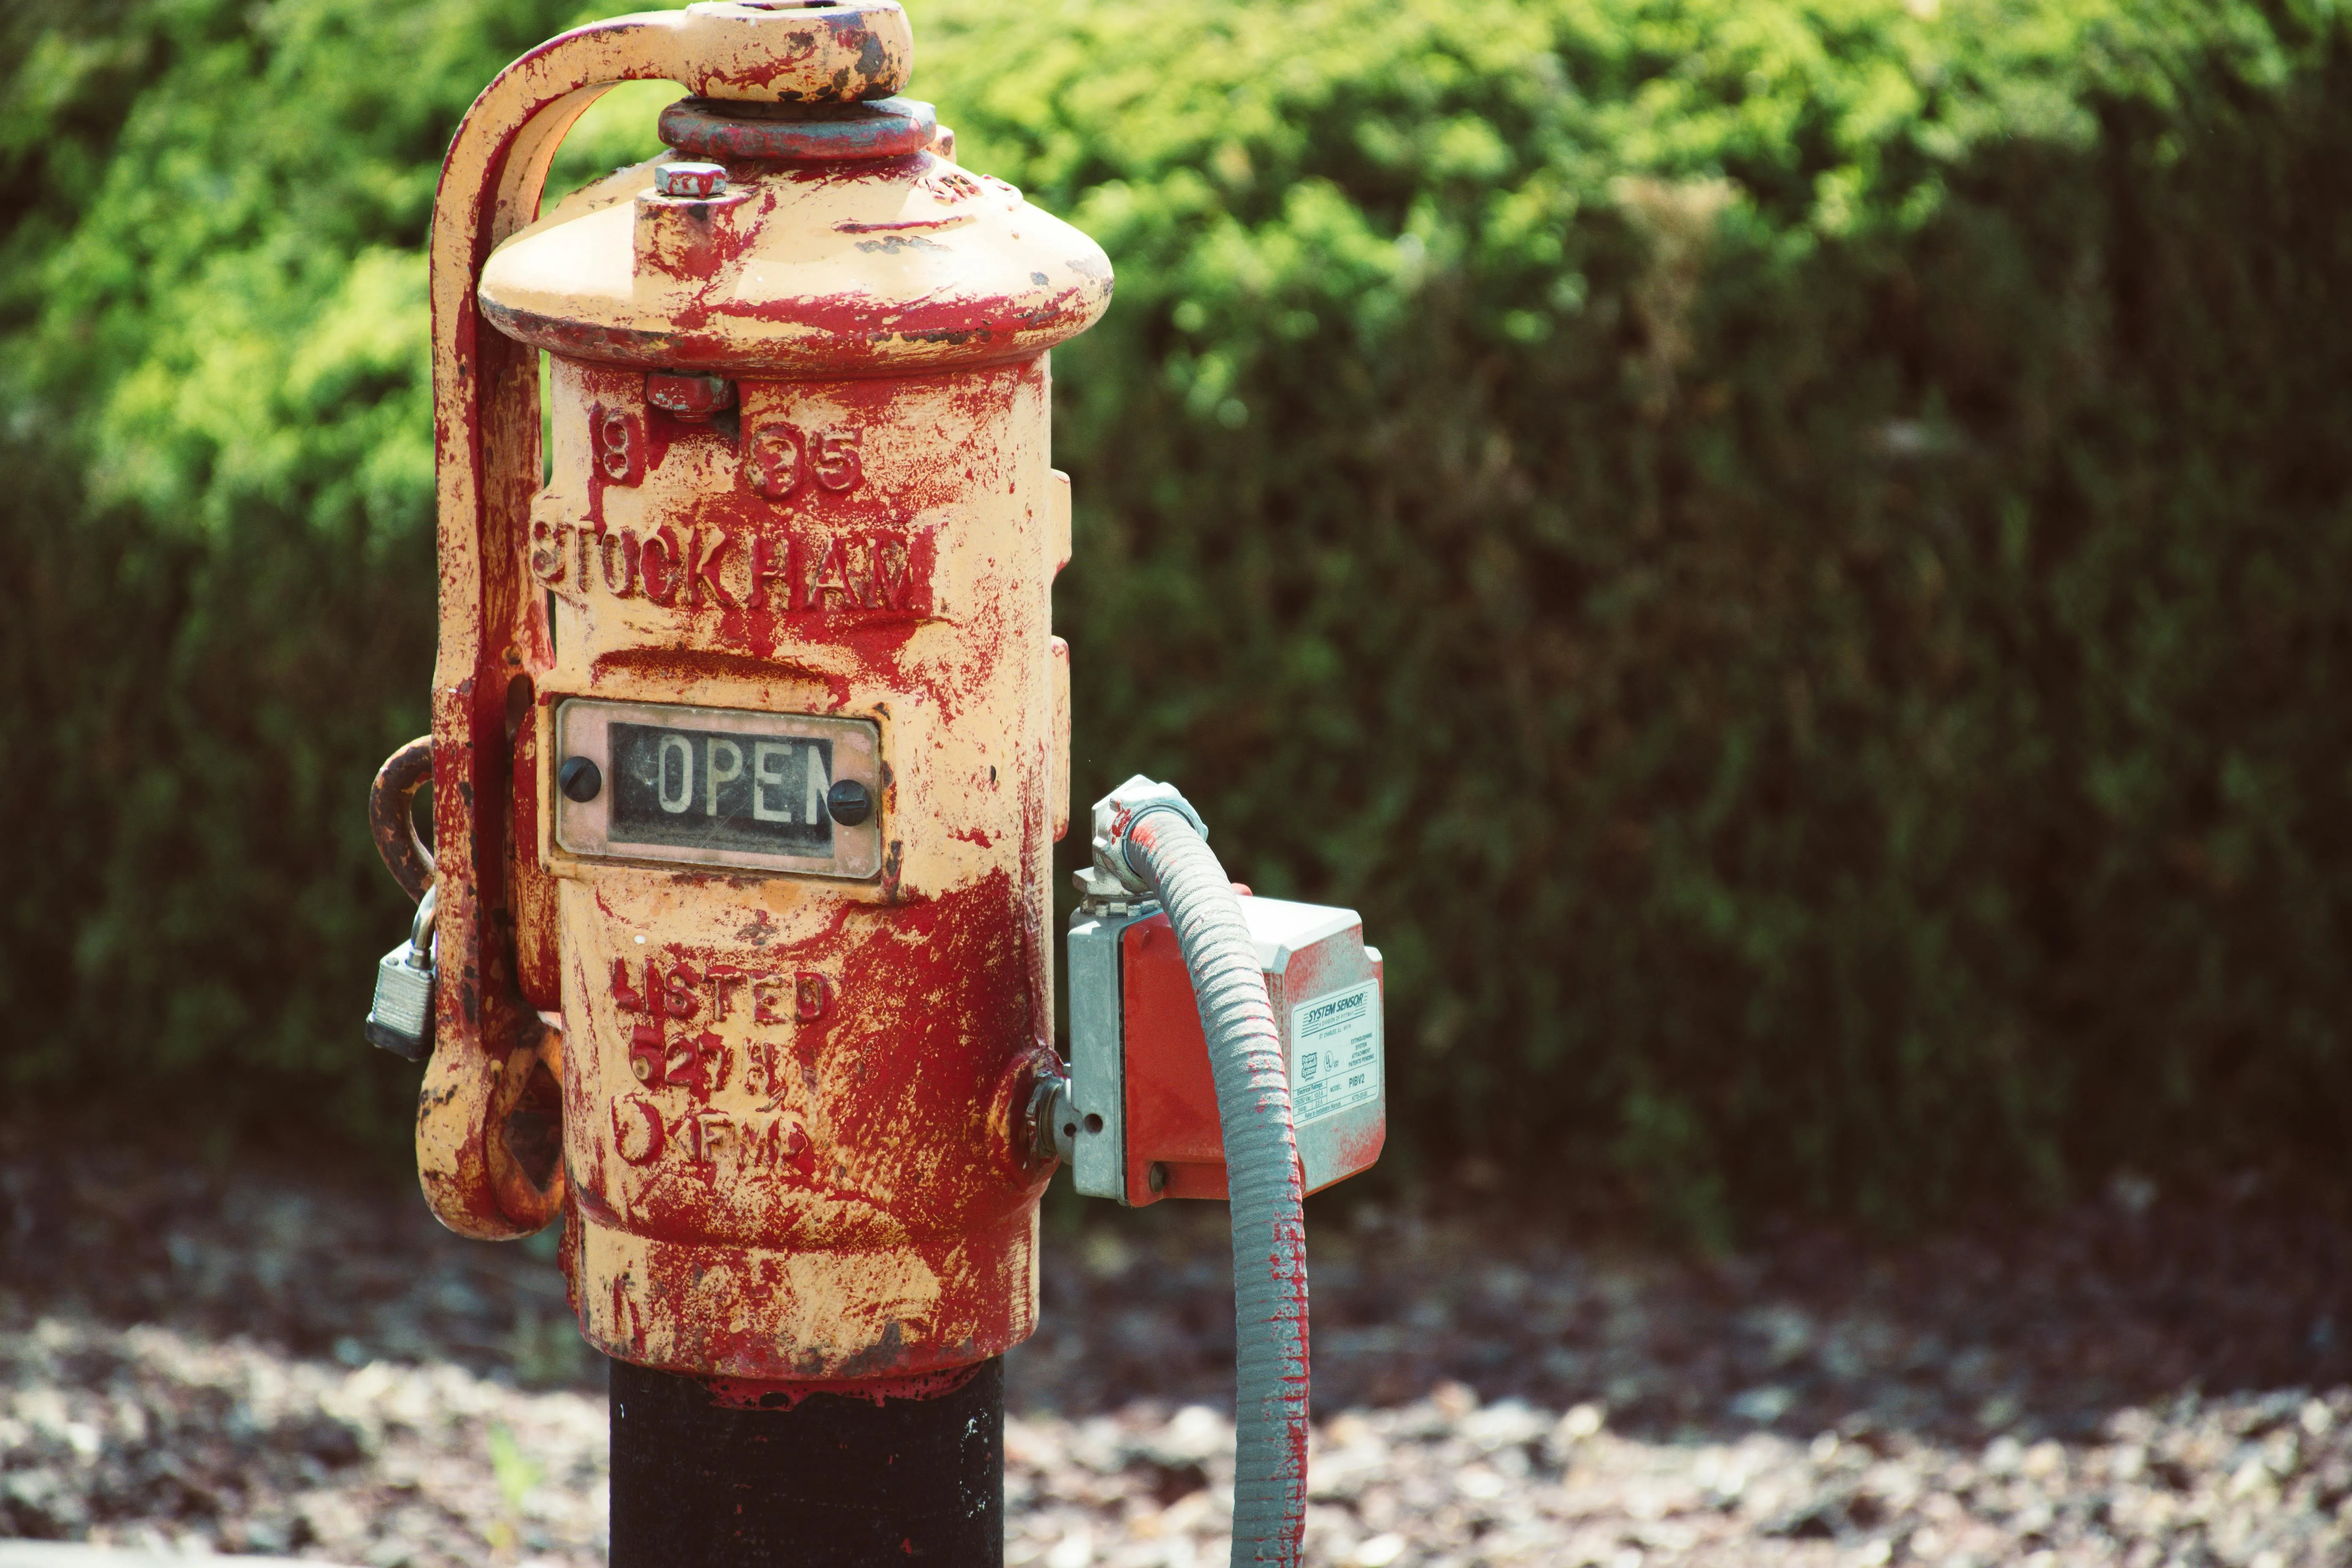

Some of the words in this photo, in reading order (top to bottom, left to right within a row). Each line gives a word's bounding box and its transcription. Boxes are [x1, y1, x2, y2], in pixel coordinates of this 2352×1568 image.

[531, 517, 917, 612] STOCKHAM
[658, 734, 834, 826] OPEN
[612, 956, 828, 1024] LISTED
[1308, 1002, 1337, 1023] SYSTEM
[1337, 993, 1364, 1012] SENSOR
[1322, 1017, 1335, 1026] DIVISION
[1341, 1011, 1354, 1020] PITTWAY
[1351, 1032, 1372, 1045] EXTINGUISHING
[1356, 1041, 1367, 1050] SYSTEM
[1302, 1052, 1317, 1065] Factory
[1352, 1048, 1371, 1059] ATTACHMENT
[1348, 1058, 1361, 1068] PATENTS
[1362, 1054, 1374, 1062] PENDING
[1301, 1066, 1316, 1078] System
[1349, 1073, 1365, 1088] PIBV2
[1297, 1086, 1311, 1096] Electrical
[1316, 1105, 1331, 1115] Installation
[1331, 1100, 1341, 1109] Manual
